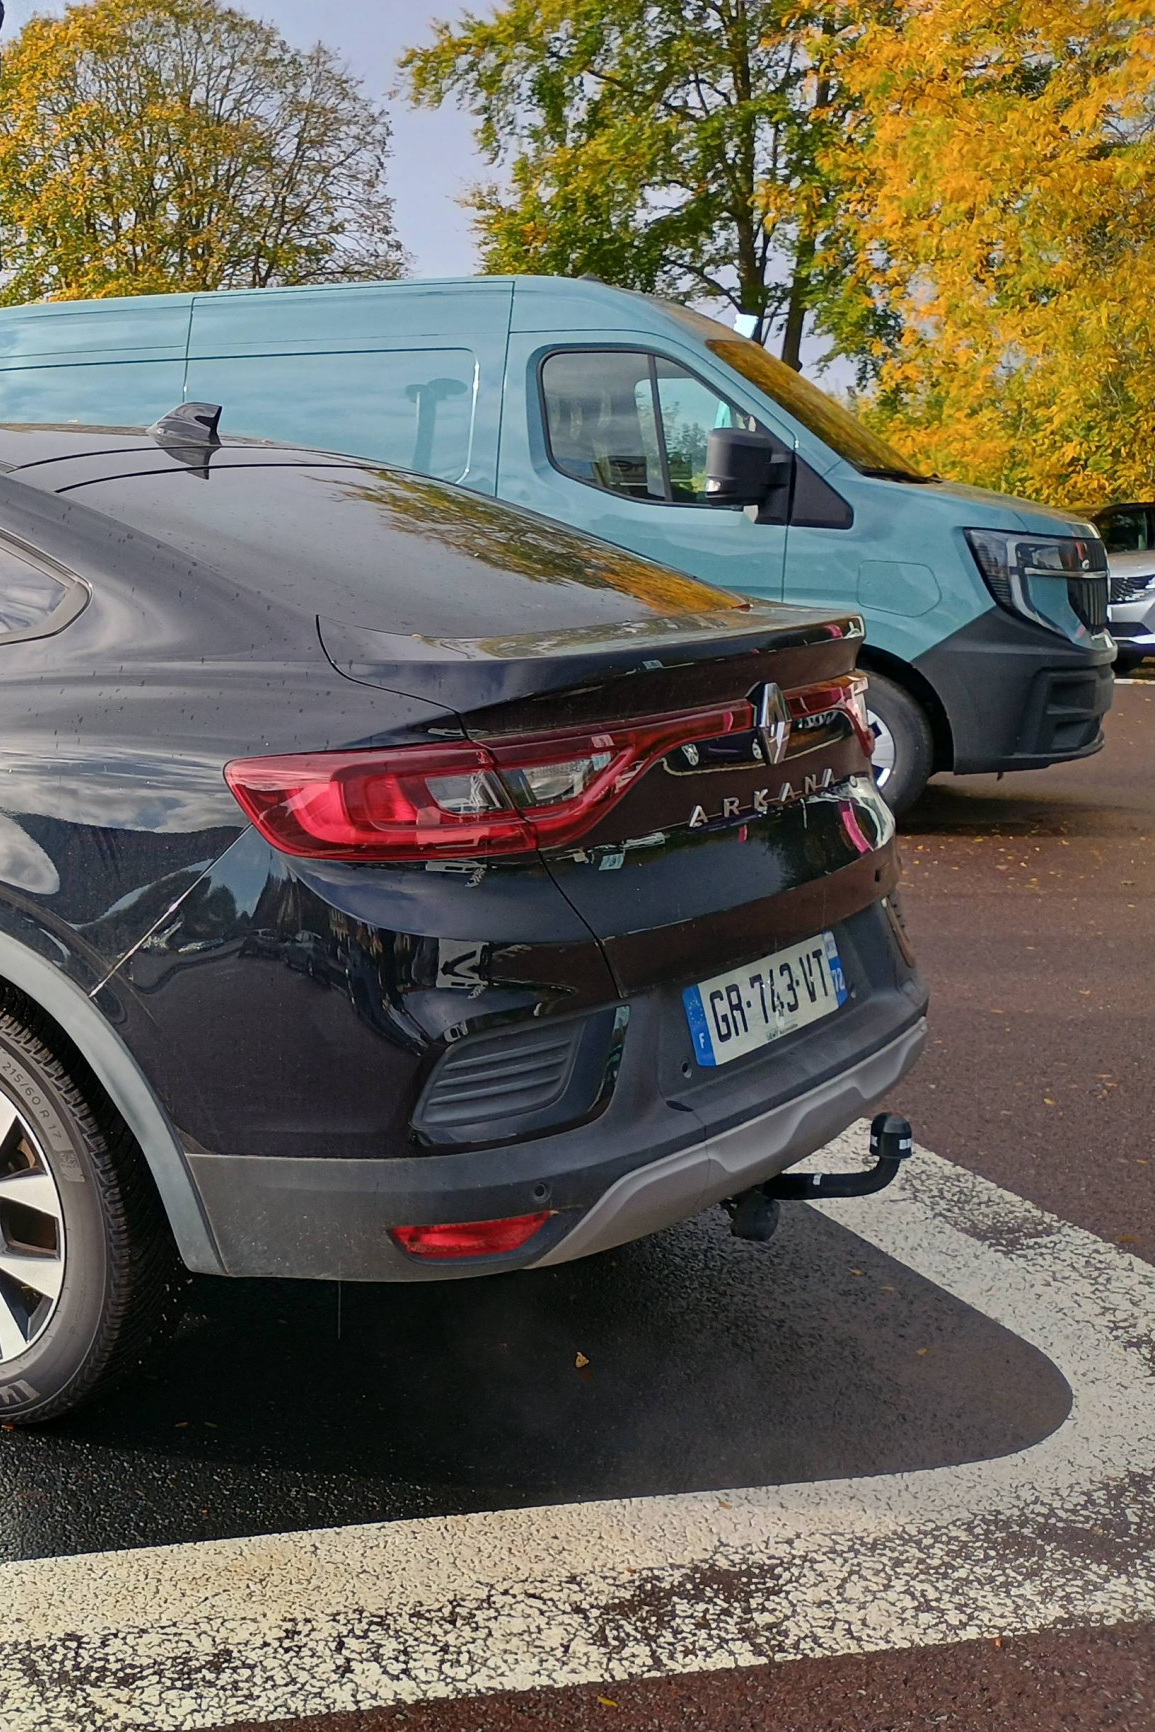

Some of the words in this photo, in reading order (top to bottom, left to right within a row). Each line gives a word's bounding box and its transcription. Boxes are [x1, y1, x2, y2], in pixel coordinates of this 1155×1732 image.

[689, 768, 836, 828] ARKANA
[709, 949, 829, 1043] GR-743-VT
[832, 967, 846, 992] 72
[698, 1032, 706, 1049] F
[2, 1061, 41, 1106] 215/60
[39, 1109, 51, 1120] R
[48, 1123, 62, 1139] 17
